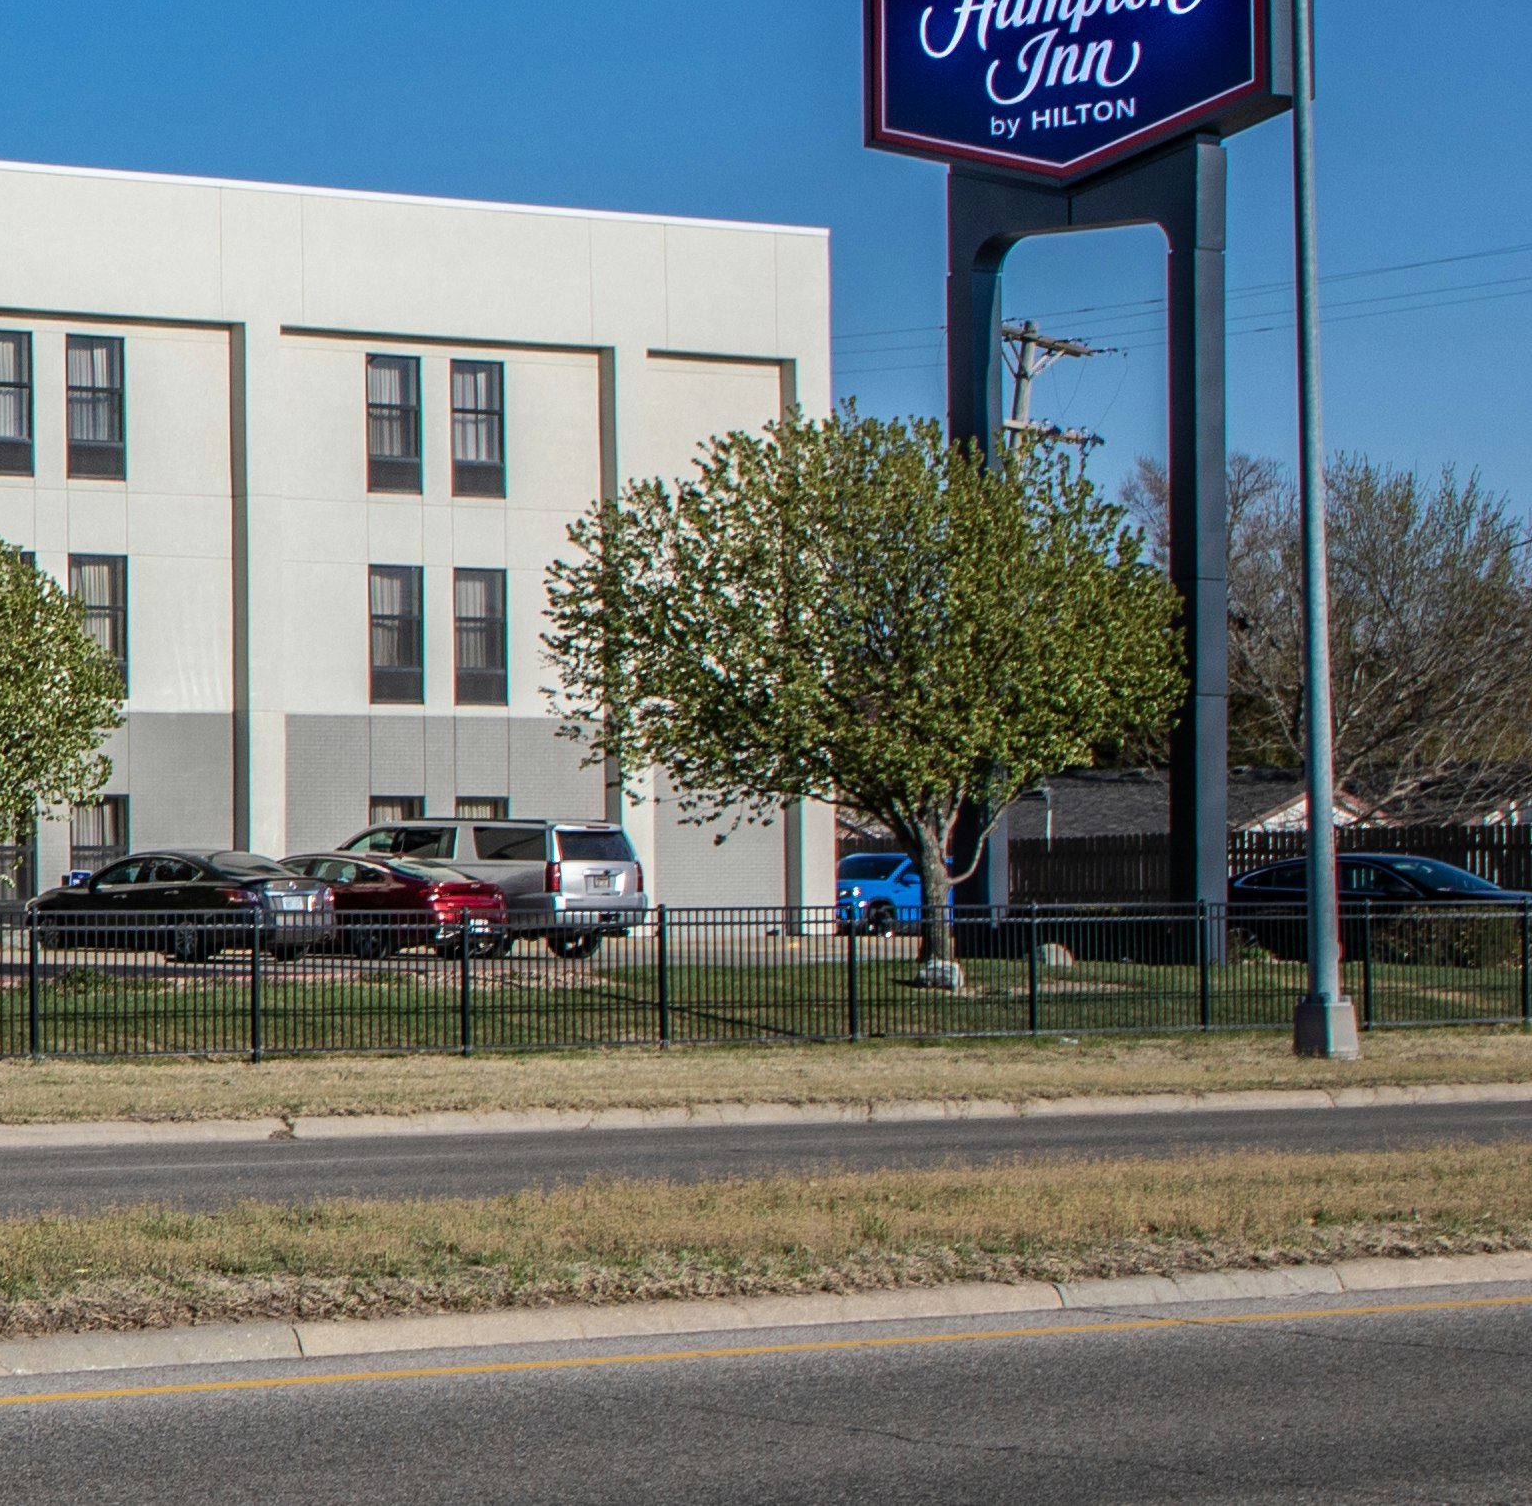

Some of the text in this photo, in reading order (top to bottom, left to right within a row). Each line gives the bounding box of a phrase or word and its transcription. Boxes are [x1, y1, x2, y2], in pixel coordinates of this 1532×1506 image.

[986, 28, 1141, 105] Inn
[990, 97, 1136, 139] by HILTON
